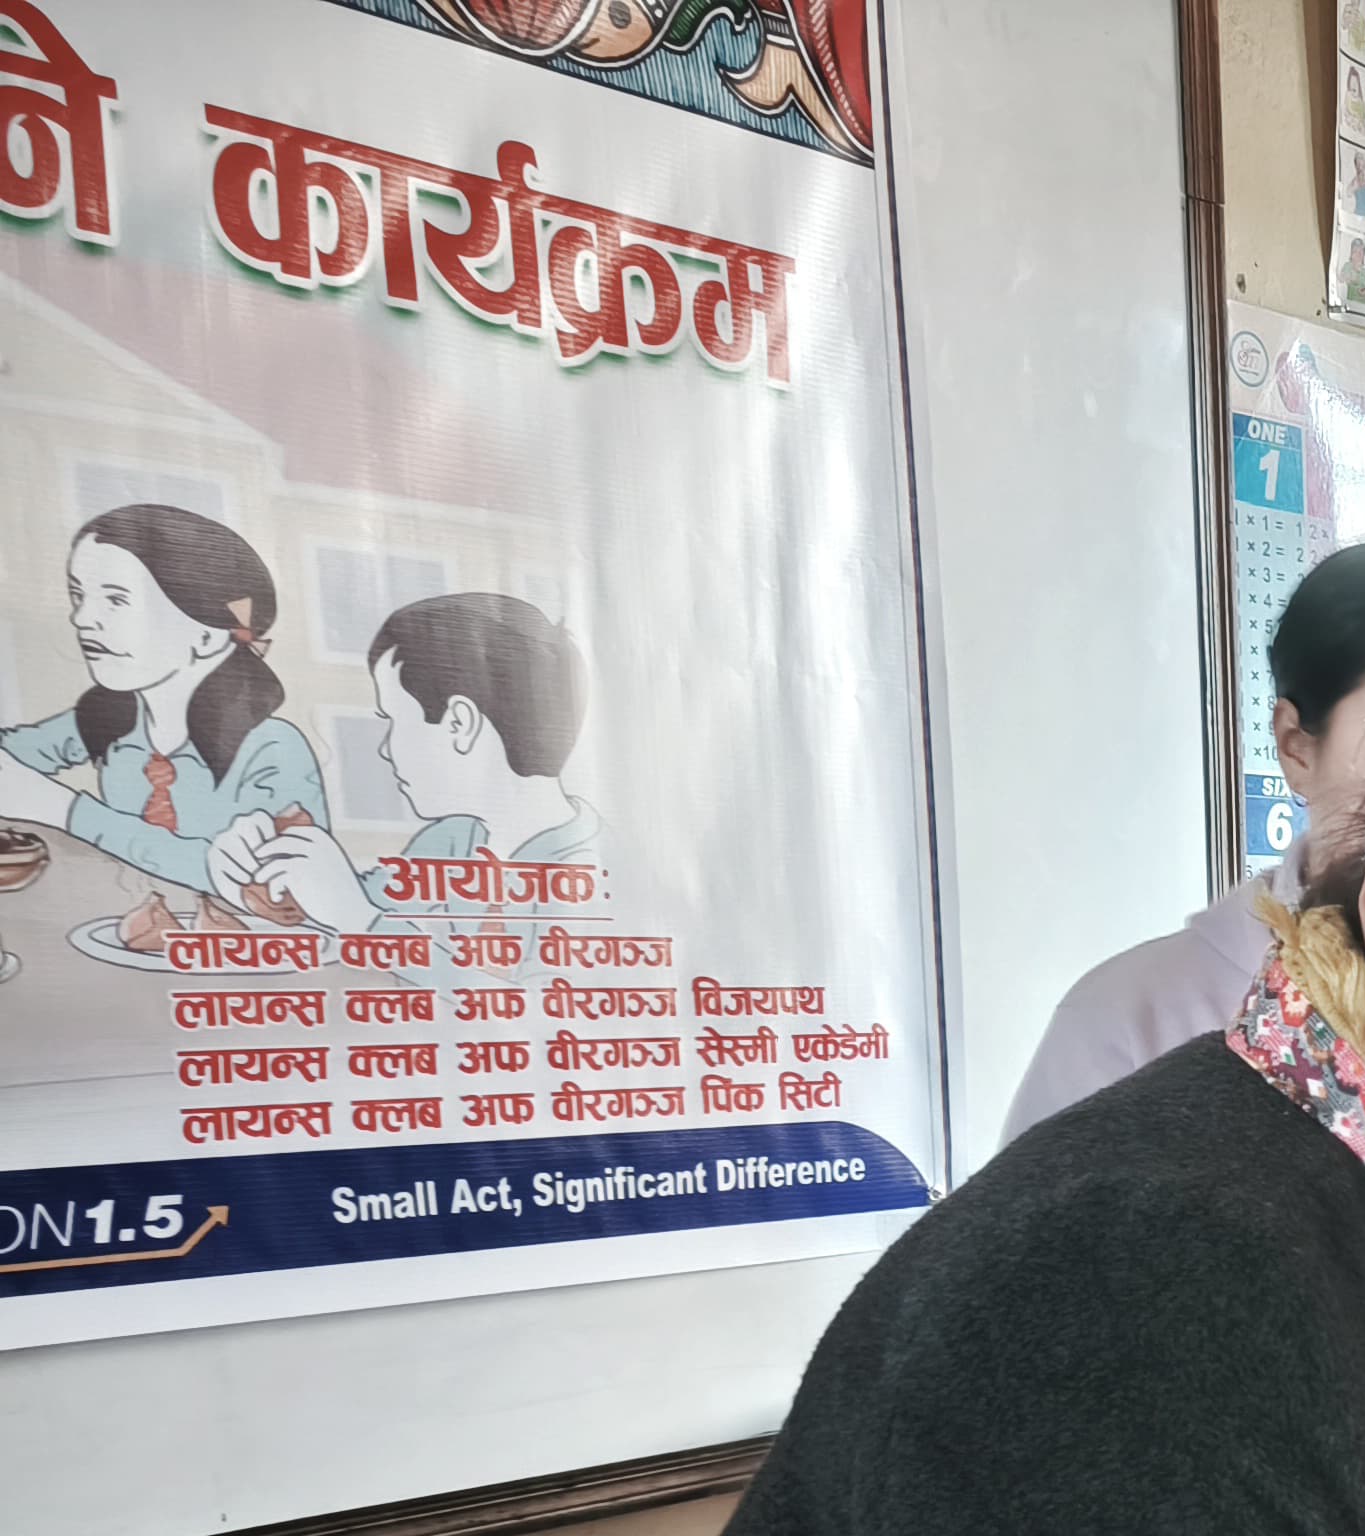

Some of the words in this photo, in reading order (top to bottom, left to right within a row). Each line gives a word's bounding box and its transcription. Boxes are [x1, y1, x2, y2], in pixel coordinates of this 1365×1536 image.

[205, 104, 796, 382] कार्यक्रम
[1247, 421, 1287, 443] ONE
[1259, 449, 1281, 501] 1
[1266, 802, 1293, 851] 6
[166, 932, 320, 971] लायन्स
[340, 933, 432, 970] क्लब
[449, 934, 522, 968] अफ
[171, 991, 326, 1029] लायन्स
[345, 989, 435, 1023] क्लब
[453, 988, 526, 1021] अफ
[692, 976, 824, 1016] विजयपथ
[177, 1047, 330, 1087] लायन्स
[347, 1044, 438, 1079] क्लब
[456, 1041, 530, 1075] अफ
[792, 1023, 889, 1062] एकेडेमी
[180, 1102, 332, 1144] लायन्स
[351, 1097, 443, 1134] क्लब
[460, 1092, 534, 1128] अफ
[779, 1071, 842, 1111] सिटी
[332, 1181, 437, 1224] Small
[451, 1178, 522, 1218] Act,
[533, 1162, 707, 1213] Significant
[715, 1156, 866, 1192] Difference
[85, 1193, 184, 1245] 1.5
